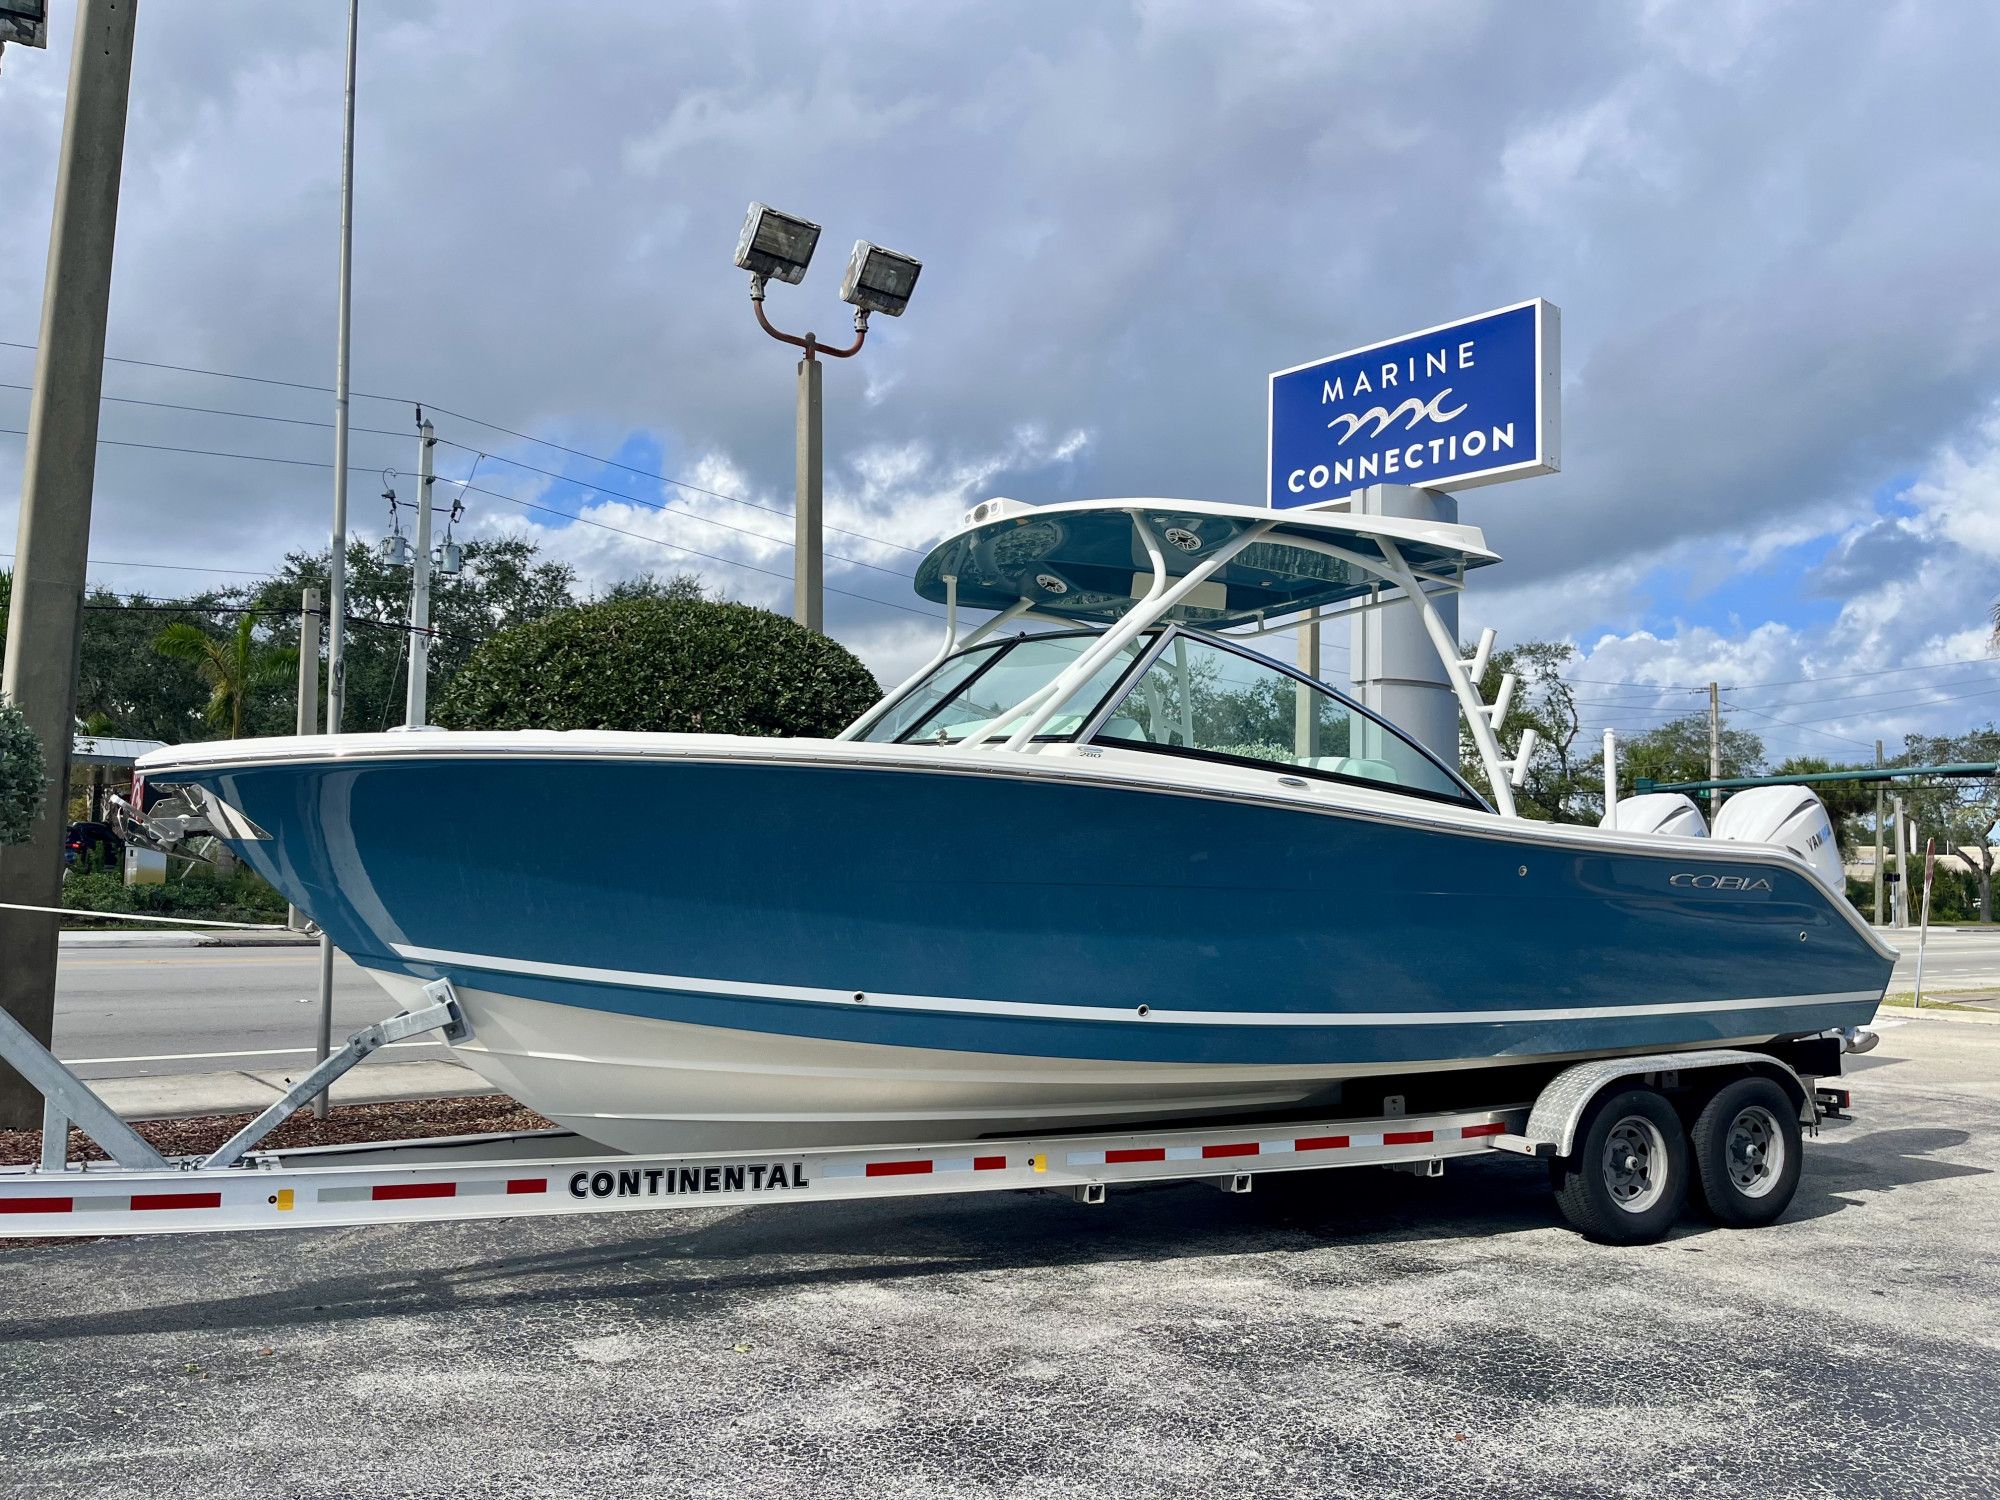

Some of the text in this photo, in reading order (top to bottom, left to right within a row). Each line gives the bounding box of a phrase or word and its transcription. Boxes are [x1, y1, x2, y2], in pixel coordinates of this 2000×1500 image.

[1321, 341, 1474, 404] MARINE
[1287, 422, 1514, 493] CONNECTION
[1669, 873, 1773, 892] COBIA
[568, 1163, 810, 1199] CONTINENTAL
